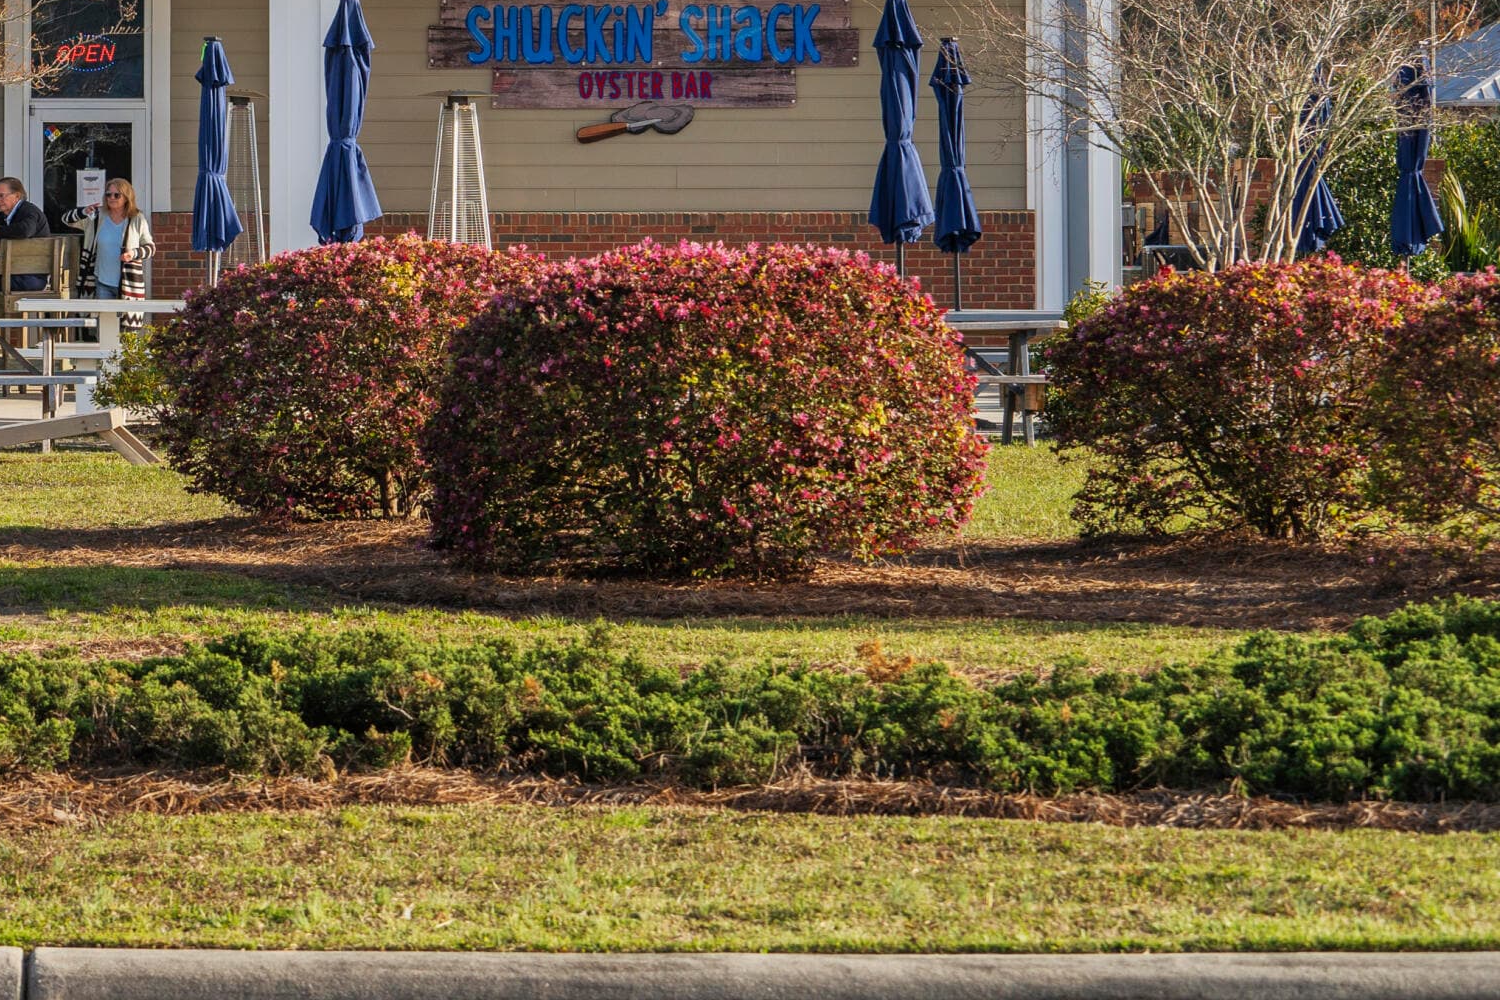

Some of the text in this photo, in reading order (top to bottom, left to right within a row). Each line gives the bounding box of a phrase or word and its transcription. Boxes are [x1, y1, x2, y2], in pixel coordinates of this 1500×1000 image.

[55, 44, 116, 63] OPEN
[578, 70, 714, 100] OYSTER BAR
